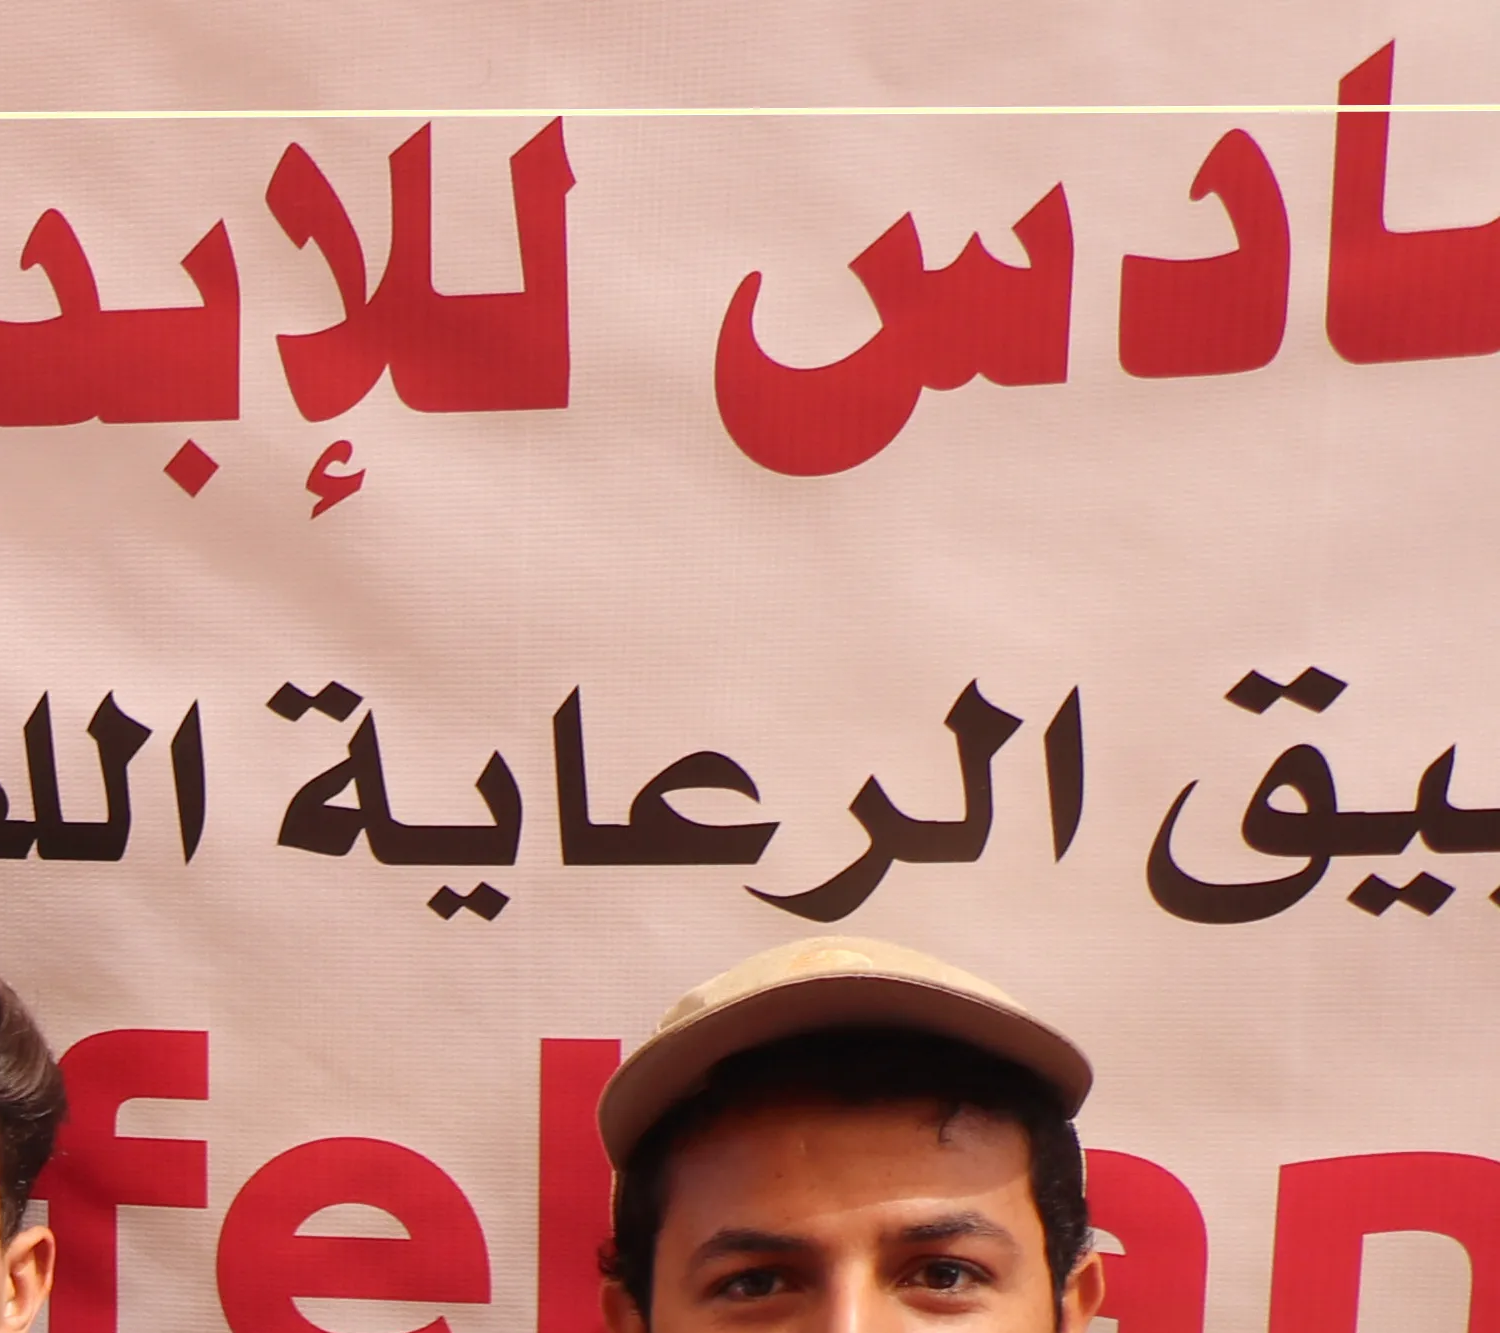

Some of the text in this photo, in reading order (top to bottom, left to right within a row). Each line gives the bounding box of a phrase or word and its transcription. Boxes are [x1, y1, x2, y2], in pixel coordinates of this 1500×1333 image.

[713, 38, 1500, 478] ادس
[268, 678, 1084, 922] الرعاية
[1146, 665, 1500, 925] يق
